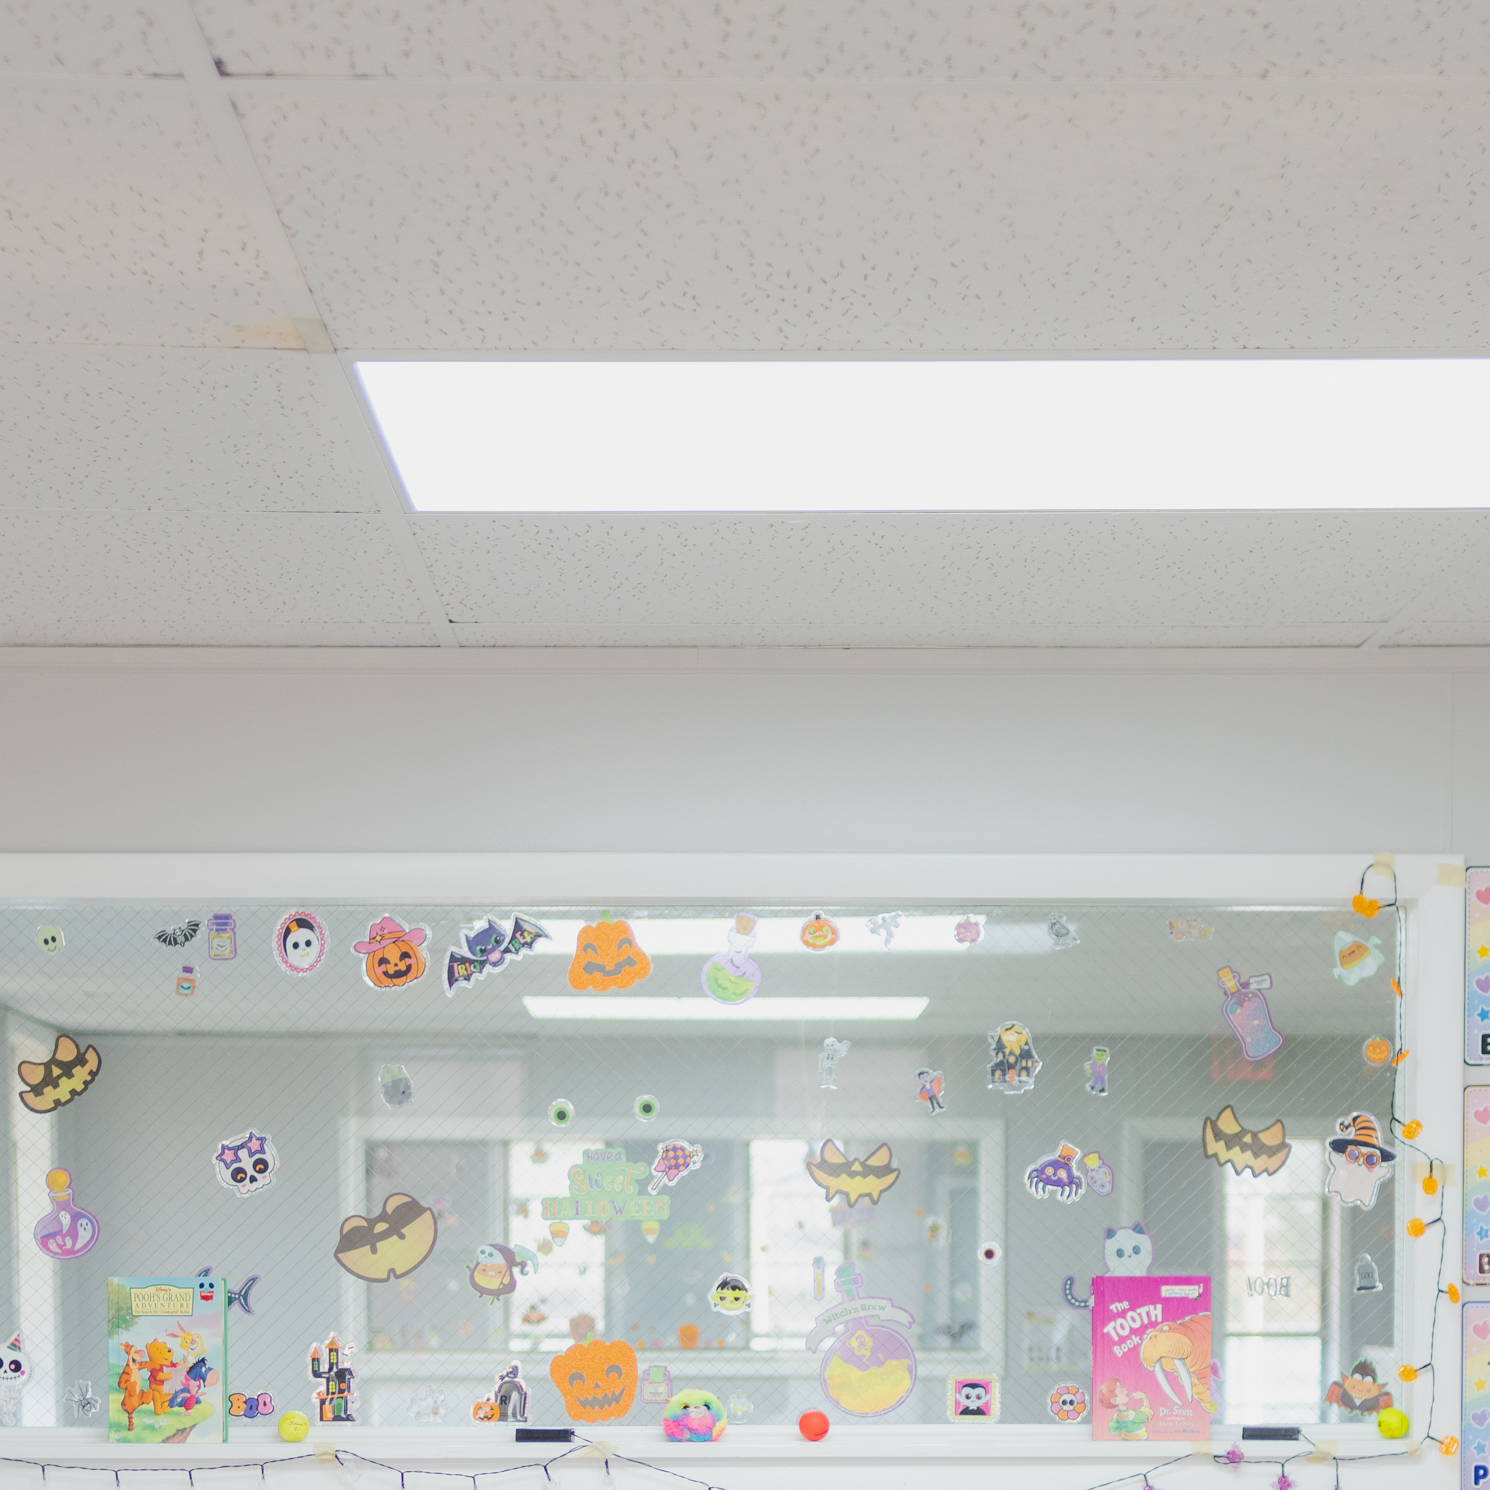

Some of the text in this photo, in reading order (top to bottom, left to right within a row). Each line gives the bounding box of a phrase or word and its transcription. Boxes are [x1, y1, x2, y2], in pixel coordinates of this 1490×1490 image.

[544, 1200, 667, 1216] HALLOWEEN
[134, 1292, 191, 1302] POOH'S GRAND
[1110, 1299, 1130, 1313] The
[823, 1306, 859, 1324] Witch's
[1103, 1304, 1162, 1342] TOOTH
[1113, 1335, 1141, 1358] Book
[229, 1392, 275, 1418] BOO
